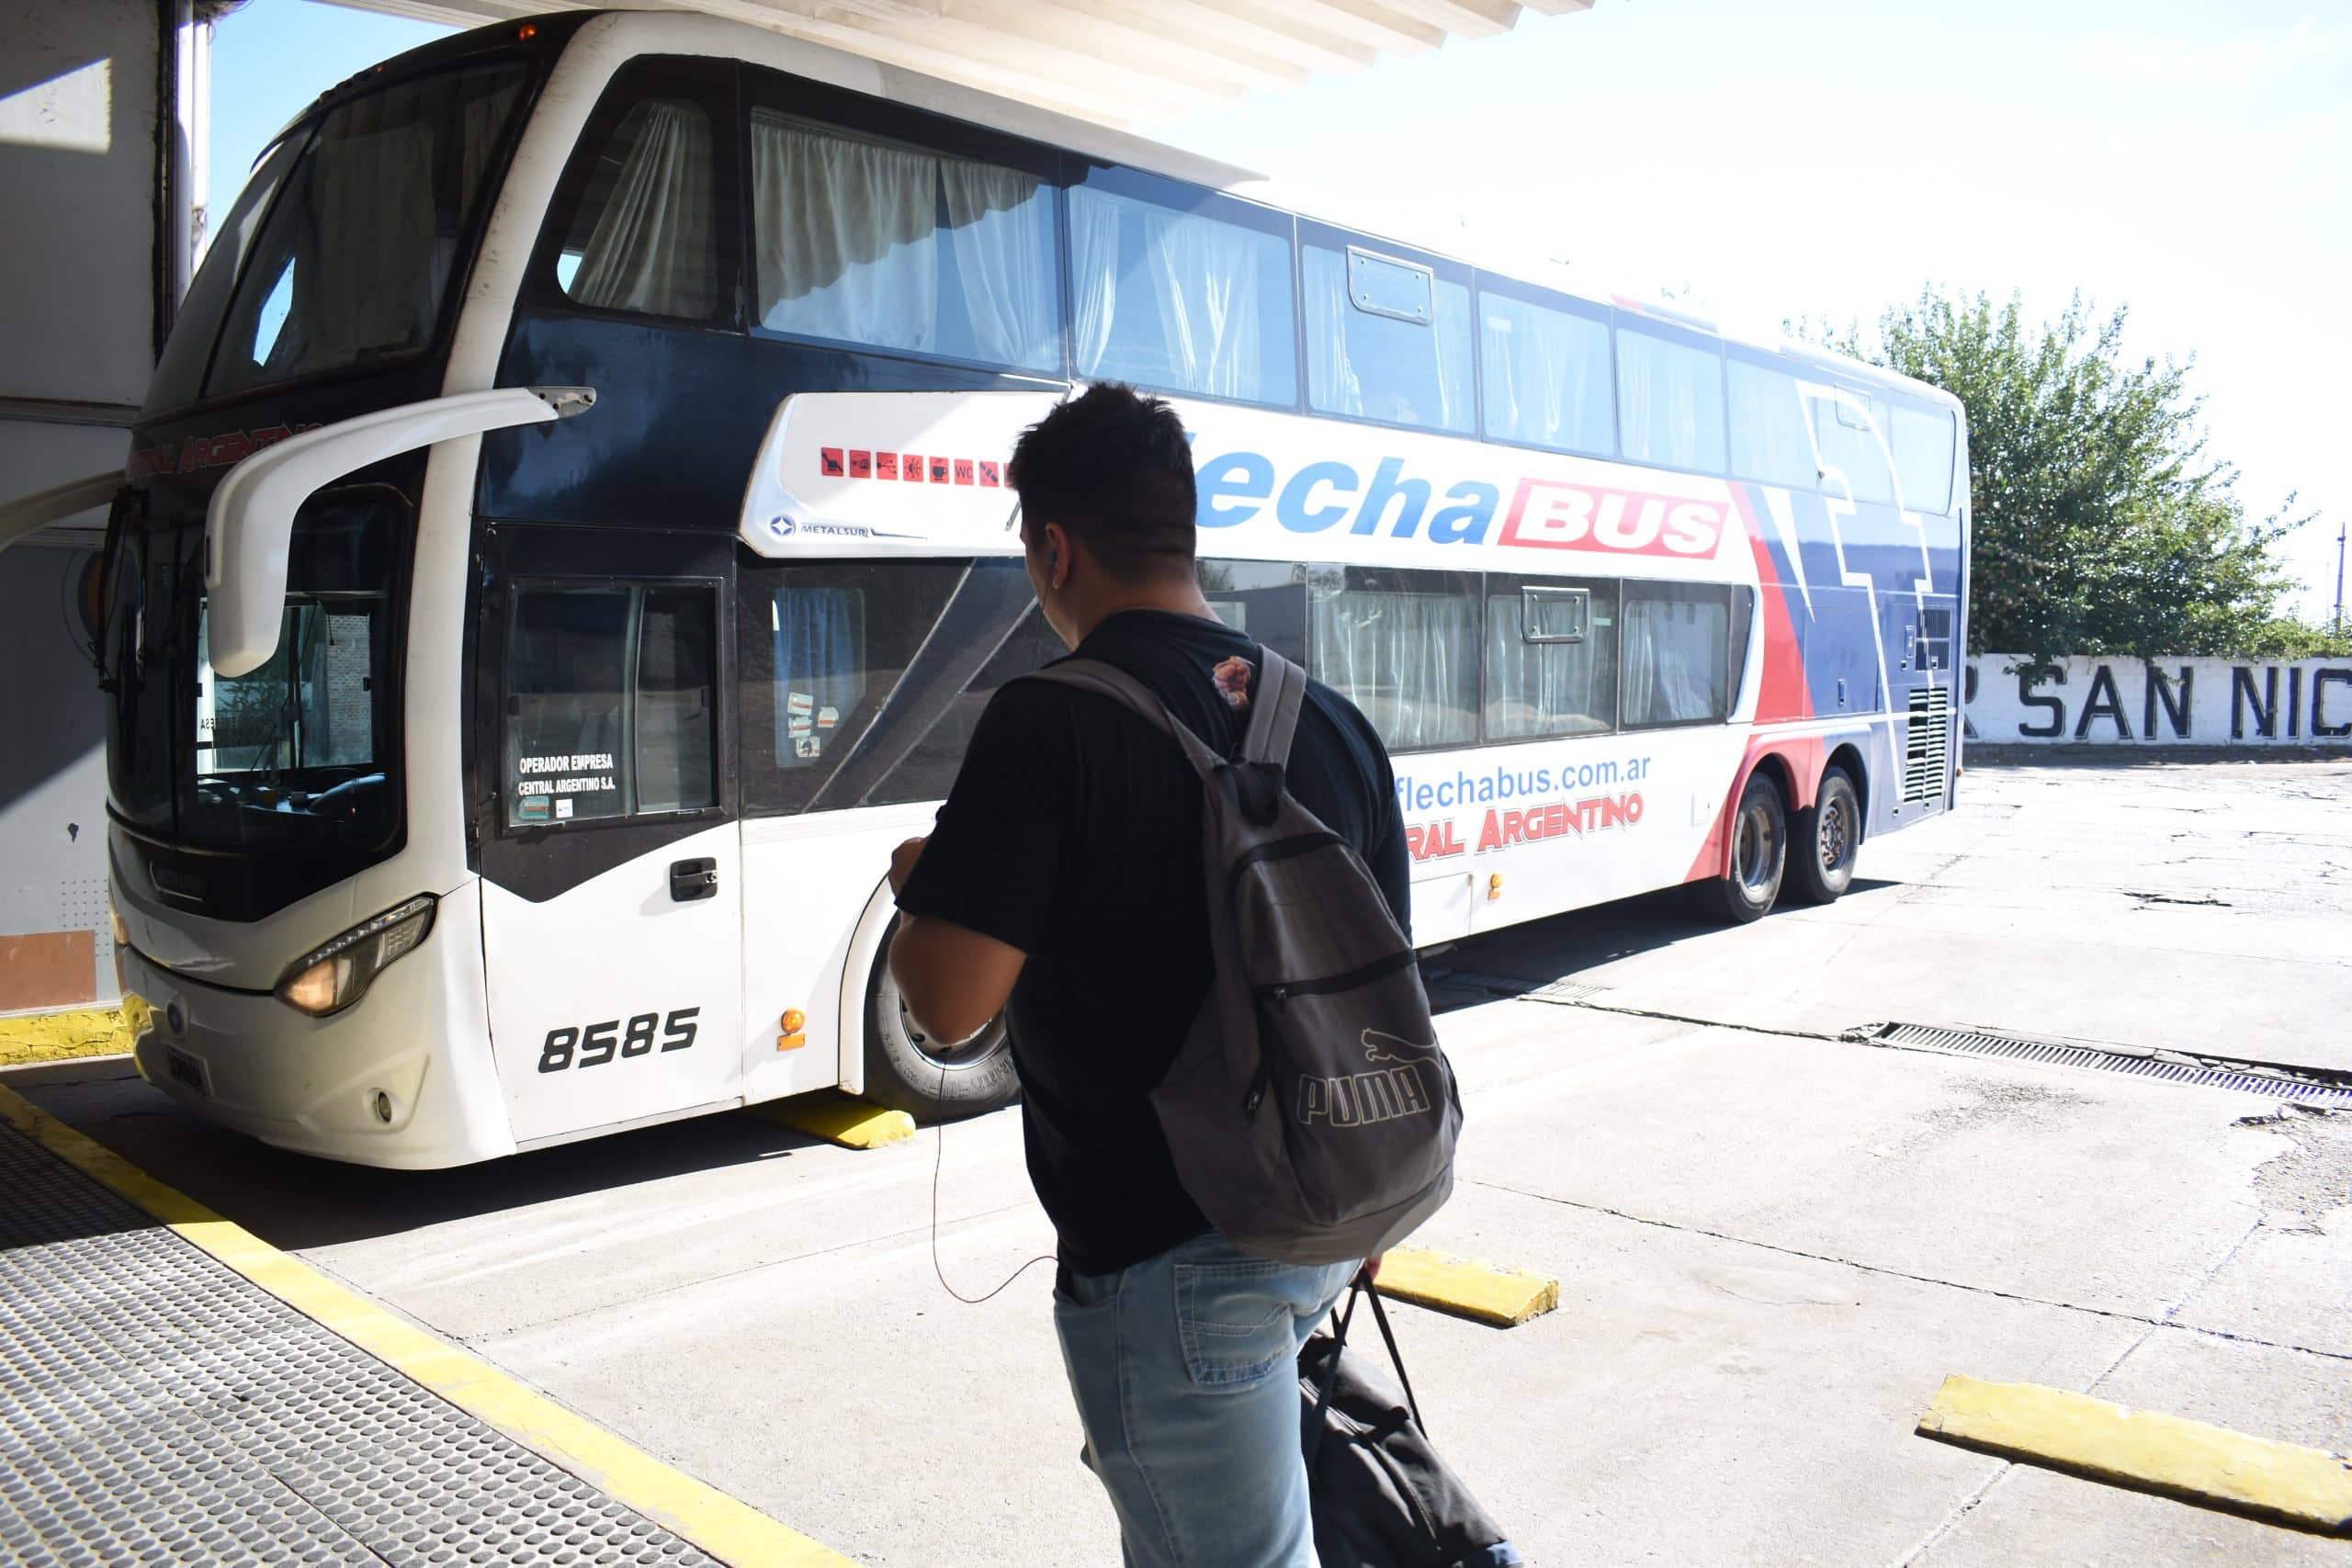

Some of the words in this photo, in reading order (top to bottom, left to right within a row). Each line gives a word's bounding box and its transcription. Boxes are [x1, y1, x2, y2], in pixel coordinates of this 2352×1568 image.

[956, 466, 973, 479] WC
[1185, 432, 1500, 546] echa
[1515, 484, 1717, 556] BUS
[800, 525, 868, 537] METALSUR
[2018, 665, 2194, 739] SAN
[2232, 666, 2352, 739] NIC
[518, 780, 554, 795] CENTRAL
[555, 777, 600, 793] ARGENTINO
[601, 776, 616, 790] S.A.
[519, 756, 570, 773] OPERADOR
[571, 753, 614, 771] EMPRESA
[1475, 792, 1645, 854] ARGENTINO
[537, 1006, 701, 1074] 8585
[1296, 1065, 1430, 1127] PUMA
